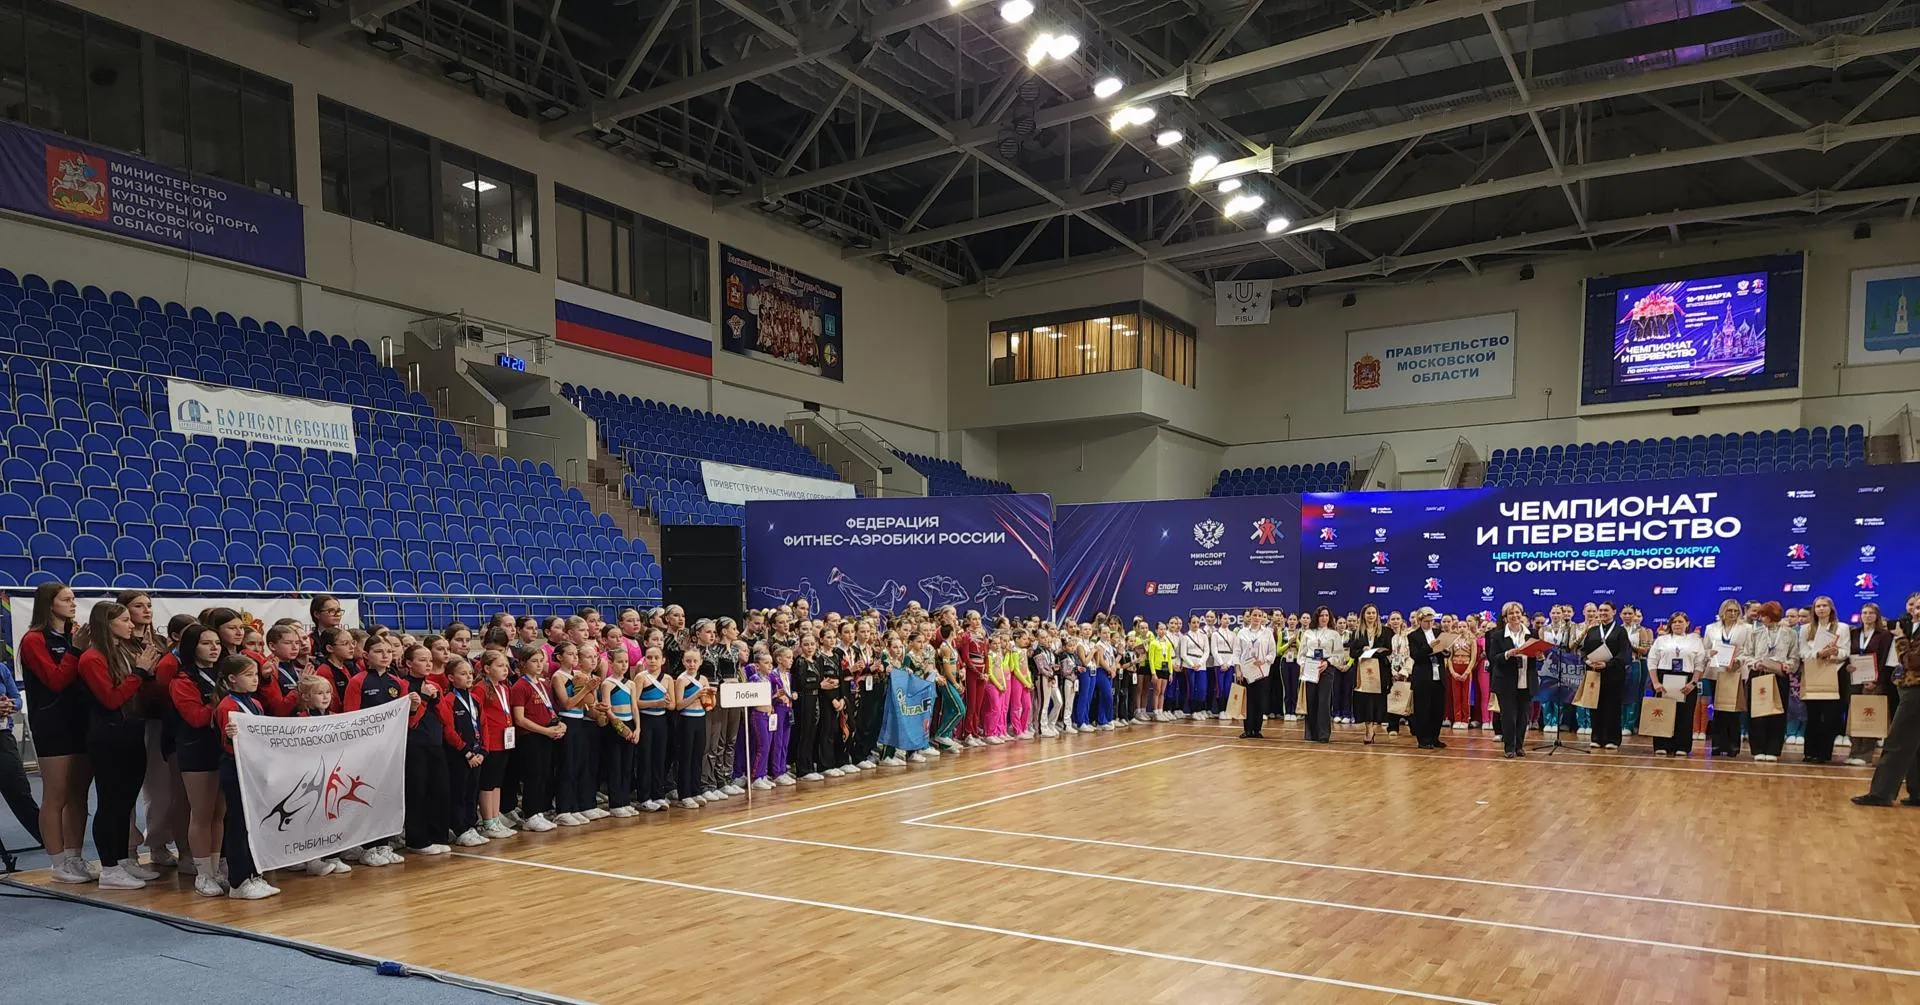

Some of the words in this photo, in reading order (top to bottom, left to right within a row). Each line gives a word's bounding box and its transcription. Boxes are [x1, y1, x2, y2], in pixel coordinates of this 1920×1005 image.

[110, 162, 227, 201] МИНИСТЕРСТВО
[111, 175, 213, 210] ФИЗИЧЕСКОЙ
[112, 189, 189, 216] КУЛЬТУРЫ
[192, 208, 202, 219] И
[205, 211, 260, 235] СПОРТА
[112, 202, 216, 236] МОСКОВСКОЙ
[113, 215, 183, 240] ОБЛАСТИ
[1385, 335, 1510, 359] ПРАВИТЕЛЬСТВО
[1621, 355, 1630, 363] И
[1630, 349, 1697, 362] ПЕРВЕНСТВО
[1625, 340, 1693, 354] ЧЕМПИОНАТ
[1397, 350, 1496, 372] МОСКОВСКОЙ
[1411, 367, 1480, 384] ОБЛАСТИ
[216, 408, 349, 441] БОРИСОГЛЕБСКИЙ
[218, 427, 294, 443] спортивный
[298, 437, 350, 449] комплекс
[709, 478, 764, 494] ПРИВЕТСТВУЕМ
[764, 487, 806, 499] УЧАСТНИКОВ
[1500, 492, 1718, 521] ЧЕМПИОНАТ
[846, 516, 939, 530] ФЕДЕРАЦИЯ
[1477, 526, 1498, 545] И
[1507, 516, 1742, 545] ПЕРВЕНСТВО
[783, 533, 935, 546] ФИТНЕС-АЭРОБИКИ
[939, 532, 1006, 545] РОССИИ
[1190, 552, 1226, 560] МИНСПОРТ
[1492, 550, 1579, 561] ЦЕНТРАЛЬНОГО
[1581, 547, 1672, 559] ФЕДЕРАЛЬНОГО
[1675, 546, 1721, 555] ОКРУГА
[1495, 560, 1521, 573] ПО
[1525, 556, 1716, 573] ФИТНЕС-АЭРОБИКЕ
[735, 690, 759, 700] Лобня
[247, 725, 308, 737] ФЕДЕРАЦИЯ
[270, 732, 339, 748] ЯРОСЛАВСКОЙ
[341, 725, 385, 741] ОБЛАСТИ
[284, 844, 293, 855] Г.
[293, 832, 344, 852] РЫБИНСК
